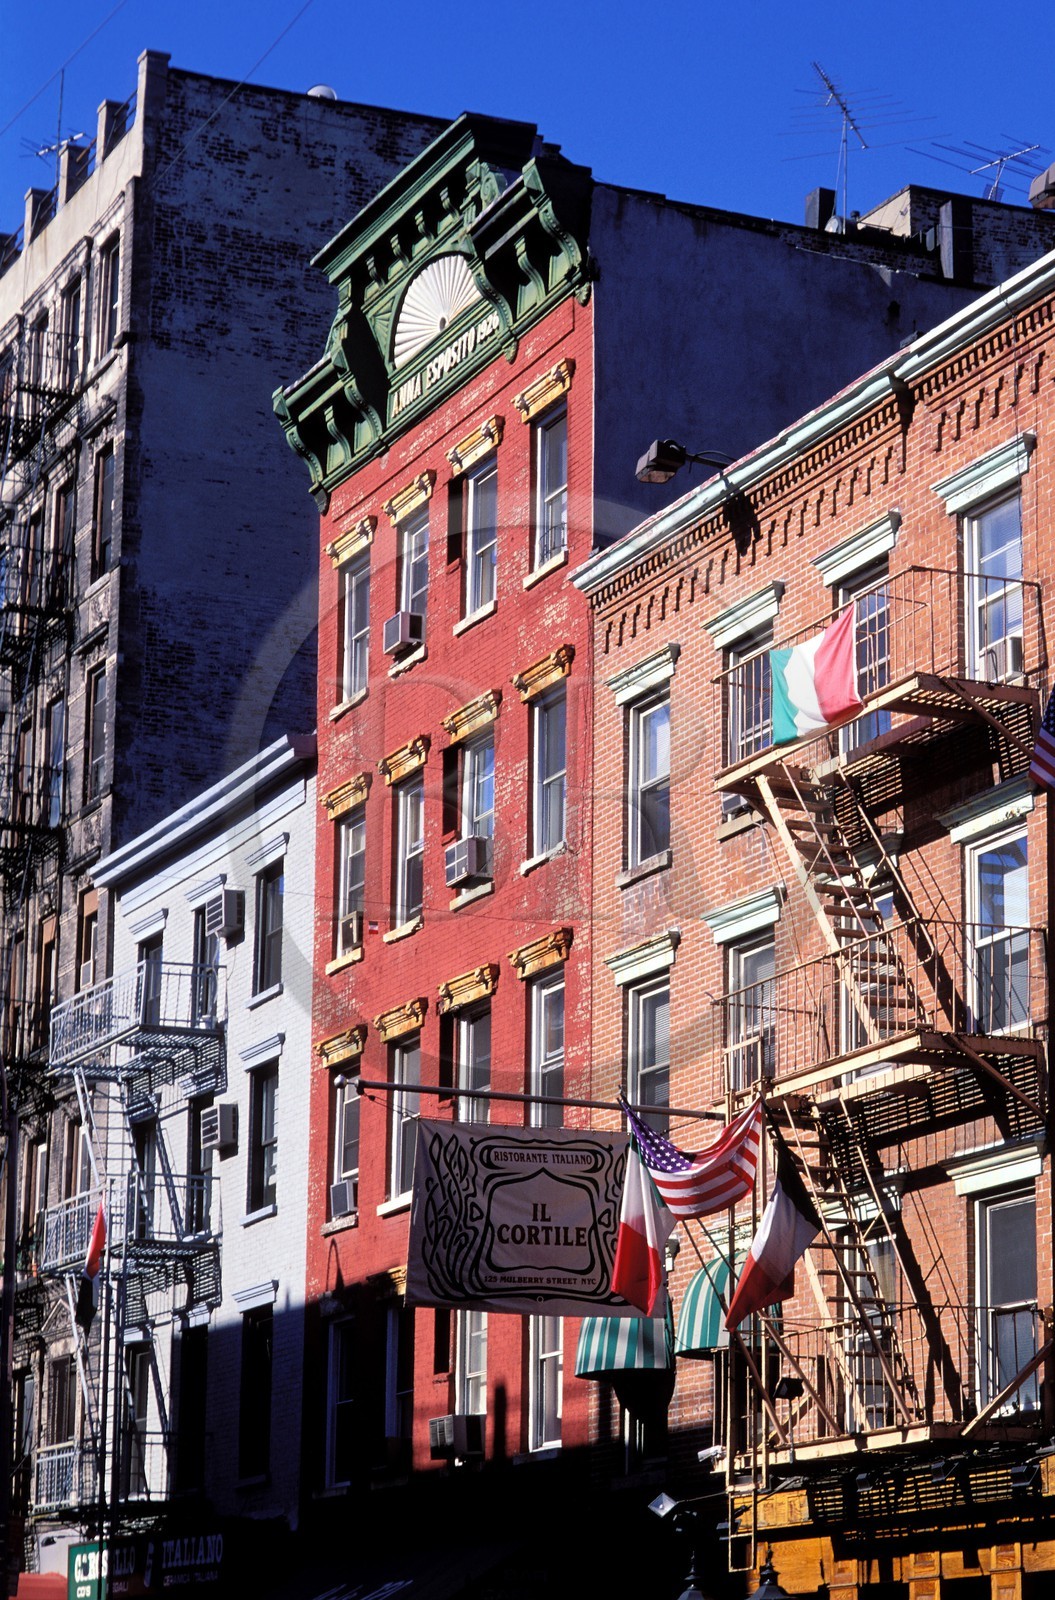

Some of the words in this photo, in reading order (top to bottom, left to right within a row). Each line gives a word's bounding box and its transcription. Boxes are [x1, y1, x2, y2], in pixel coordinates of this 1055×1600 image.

[391, 371, 422, 419] ANNA
[425, 326, 476, 391] ESPOSITO
[493, 1150, 549, 1164] RISTORANTE
[551, 1153, 593, 1165] ITALIANO
[531, 1203, 552, 1222] IL
[497, 1224, 587, 1247] CORTILE
[484, 1275, 498, 1283] 125
[499, 1275, 545, 1285] MULBERRY
[546, 1277, 578, 1285] STREET
[581, 1278, 597, 1286] NYC
[161, 1532, 224, 1569] ITALIANO
